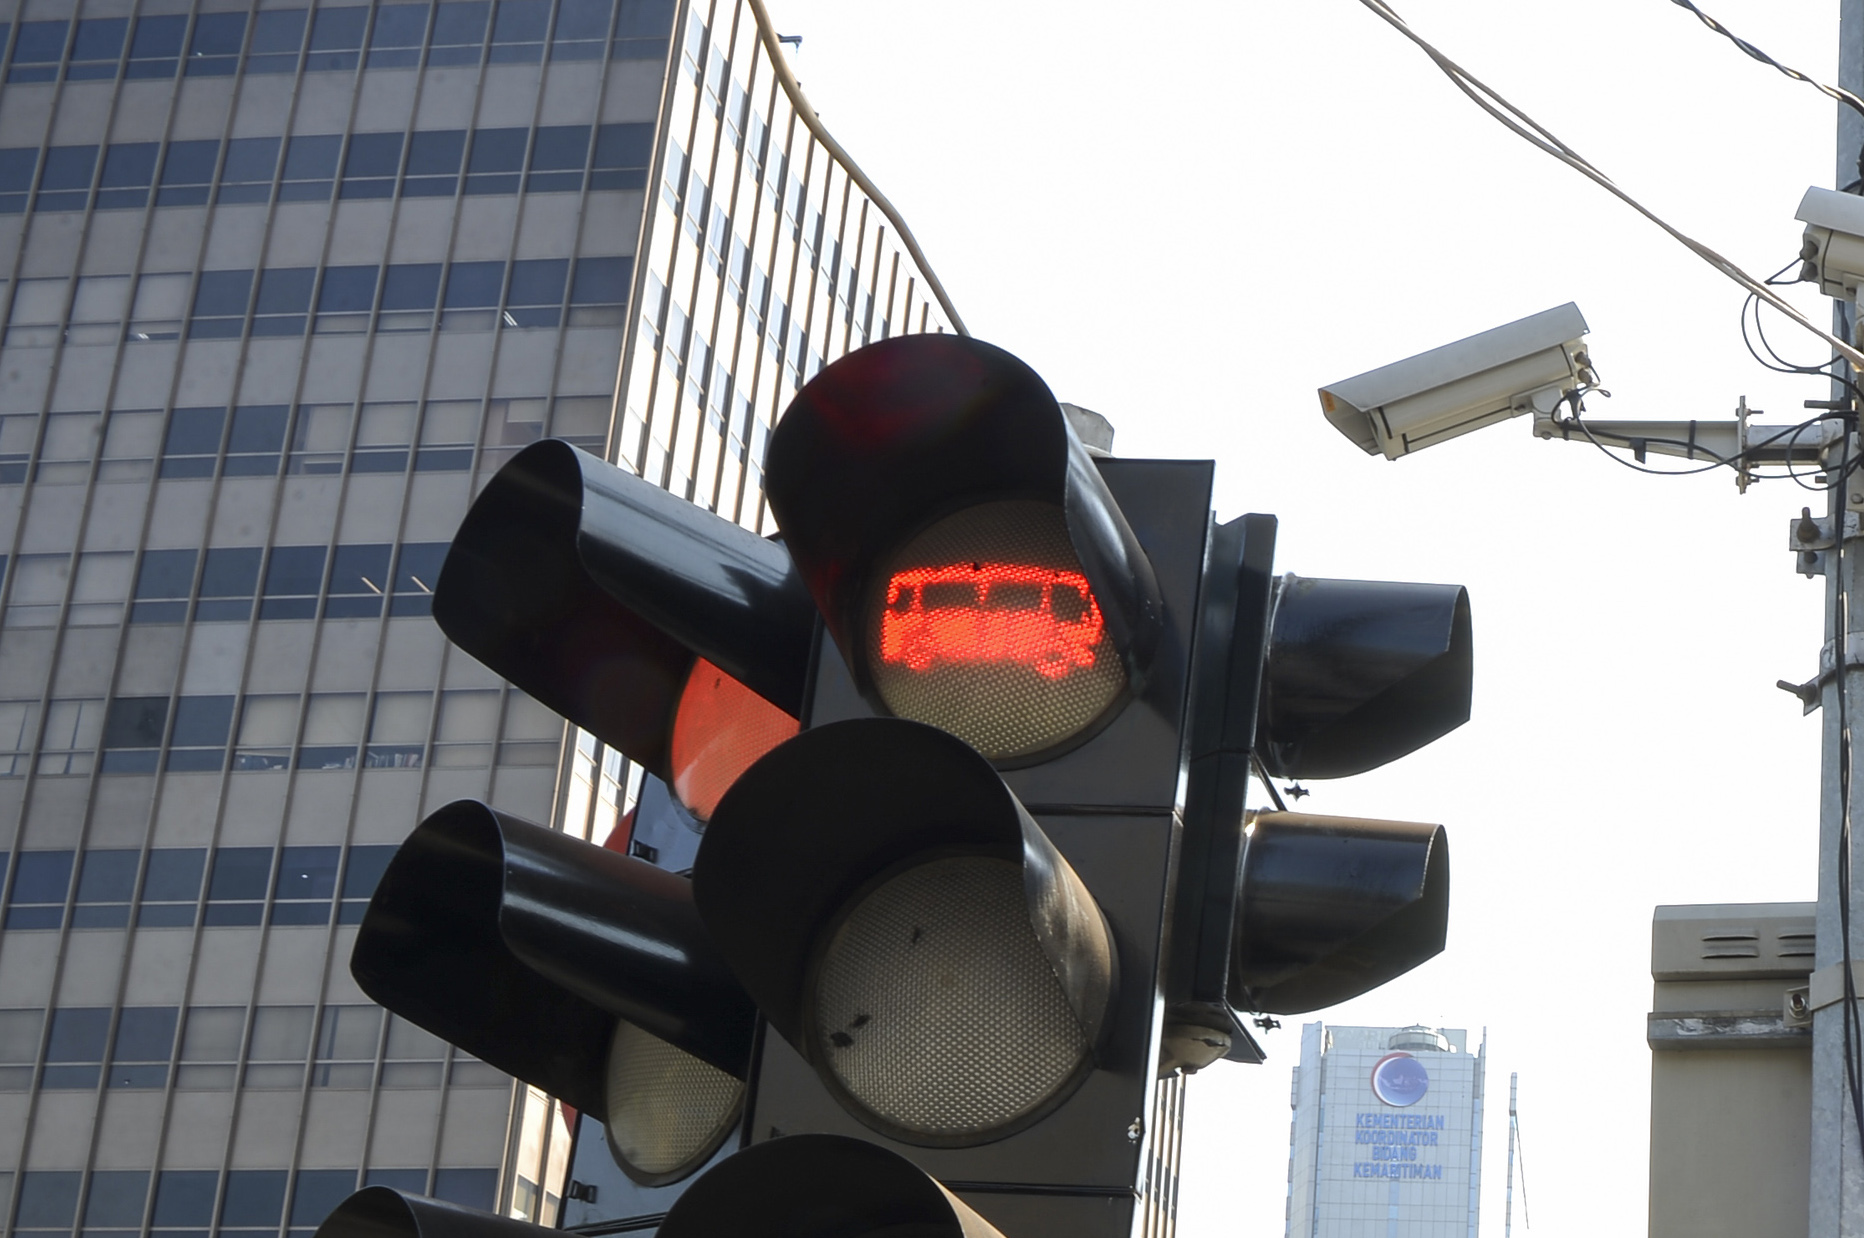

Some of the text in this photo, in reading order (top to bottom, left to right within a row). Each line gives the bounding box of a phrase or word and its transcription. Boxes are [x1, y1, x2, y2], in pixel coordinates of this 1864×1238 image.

[1356, 1113, 1444, 1130] KEMENTERIAN
[1355, 1130, 1438, 1146] KOORDINATOR
[1372, 1146, 1417, 1161] BIDANG
[1353, 1162, 1442, 1179] KEMARITIMAN
